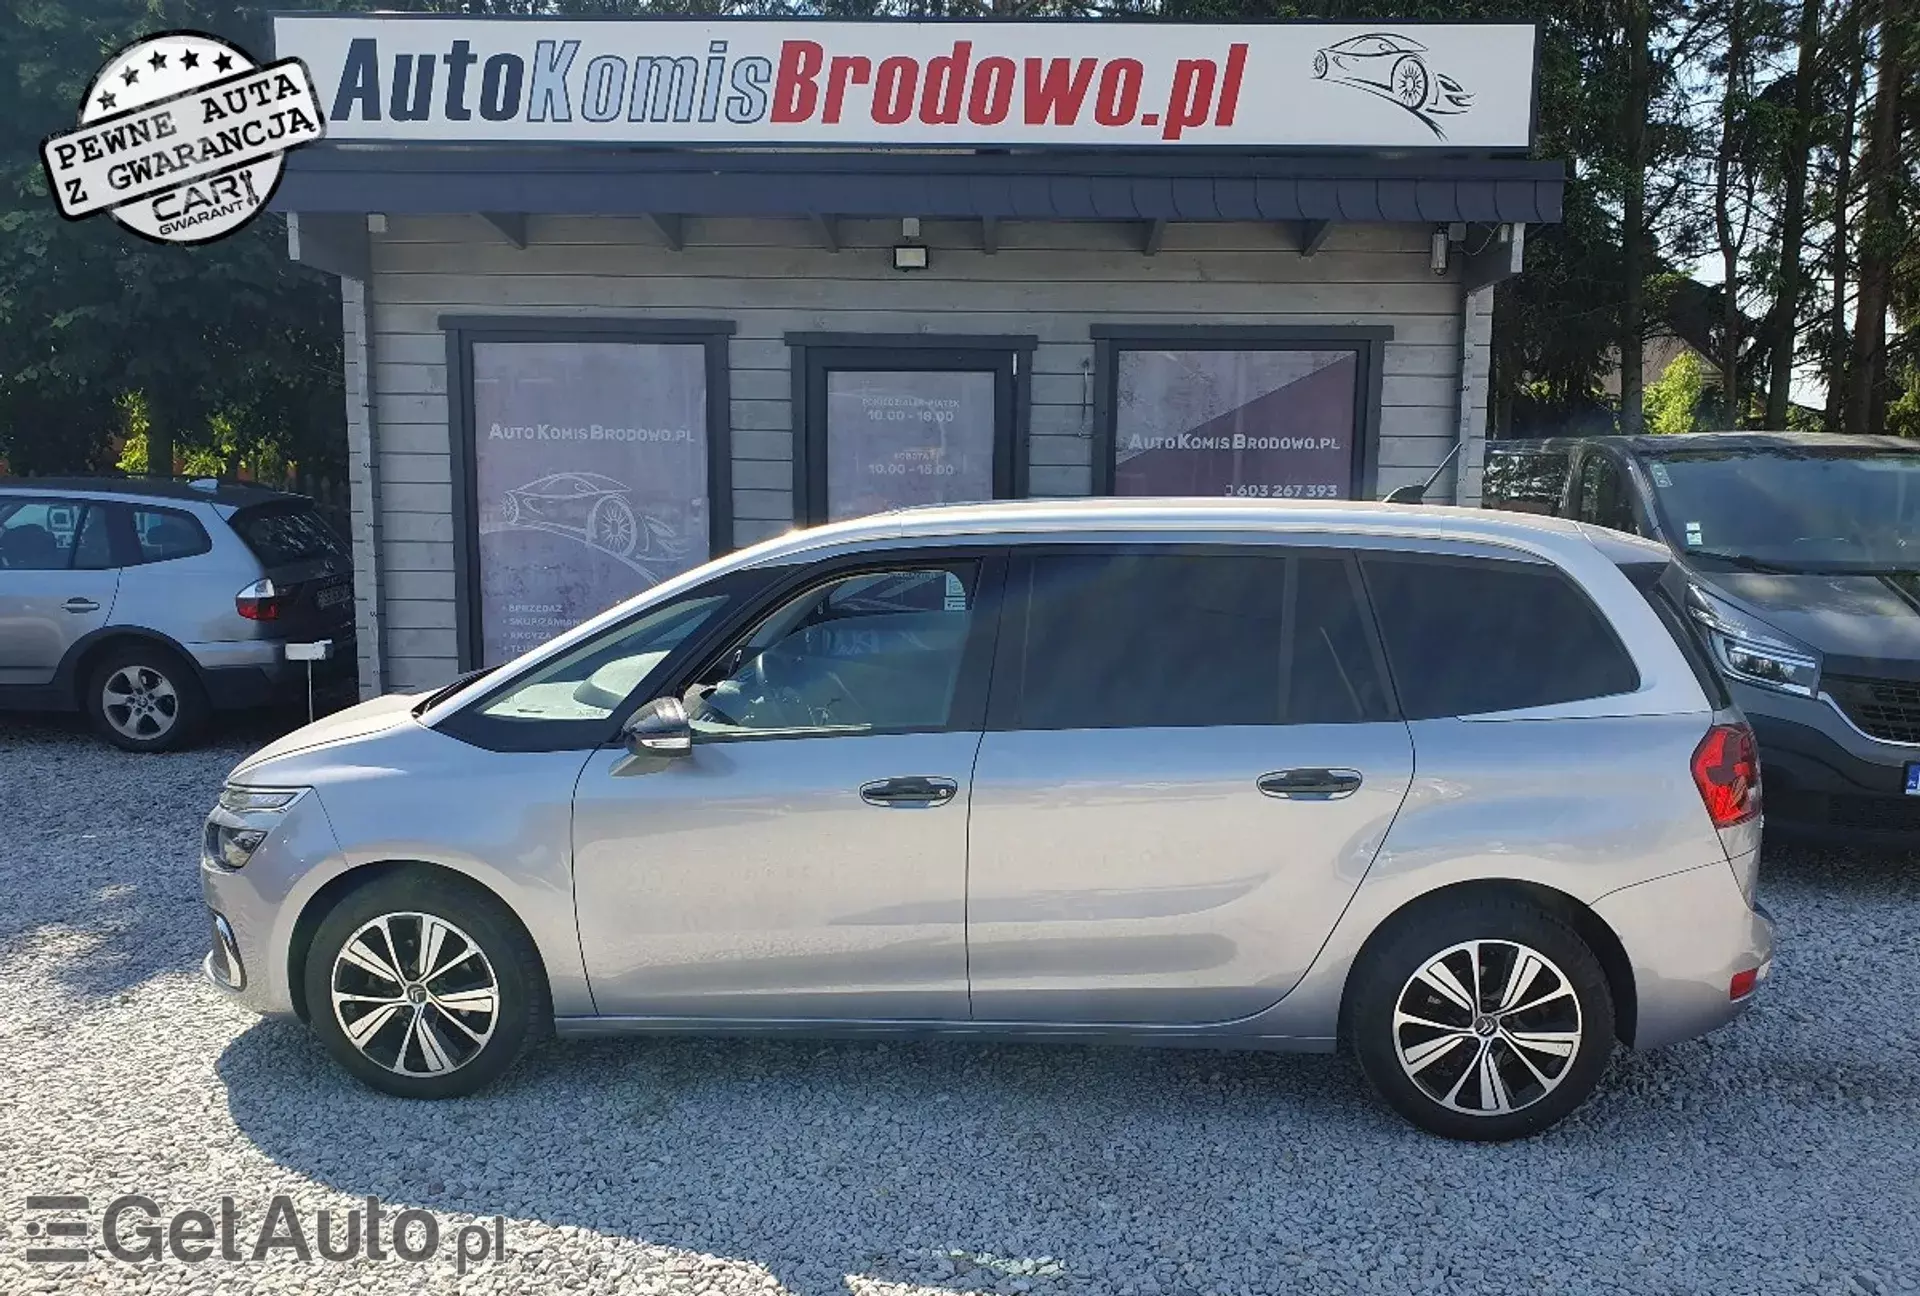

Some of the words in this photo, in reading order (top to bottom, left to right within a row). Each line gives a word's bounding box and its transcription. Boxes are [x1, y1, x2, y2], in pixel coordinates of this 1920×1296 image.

[330, 36, 1249, 141] AutoKomisBrodowo.pl
[1237, 485, 1268, 498] 603
[1272, 485, 1301, 498] 267
[1306, 485, 1338, 498] 393
